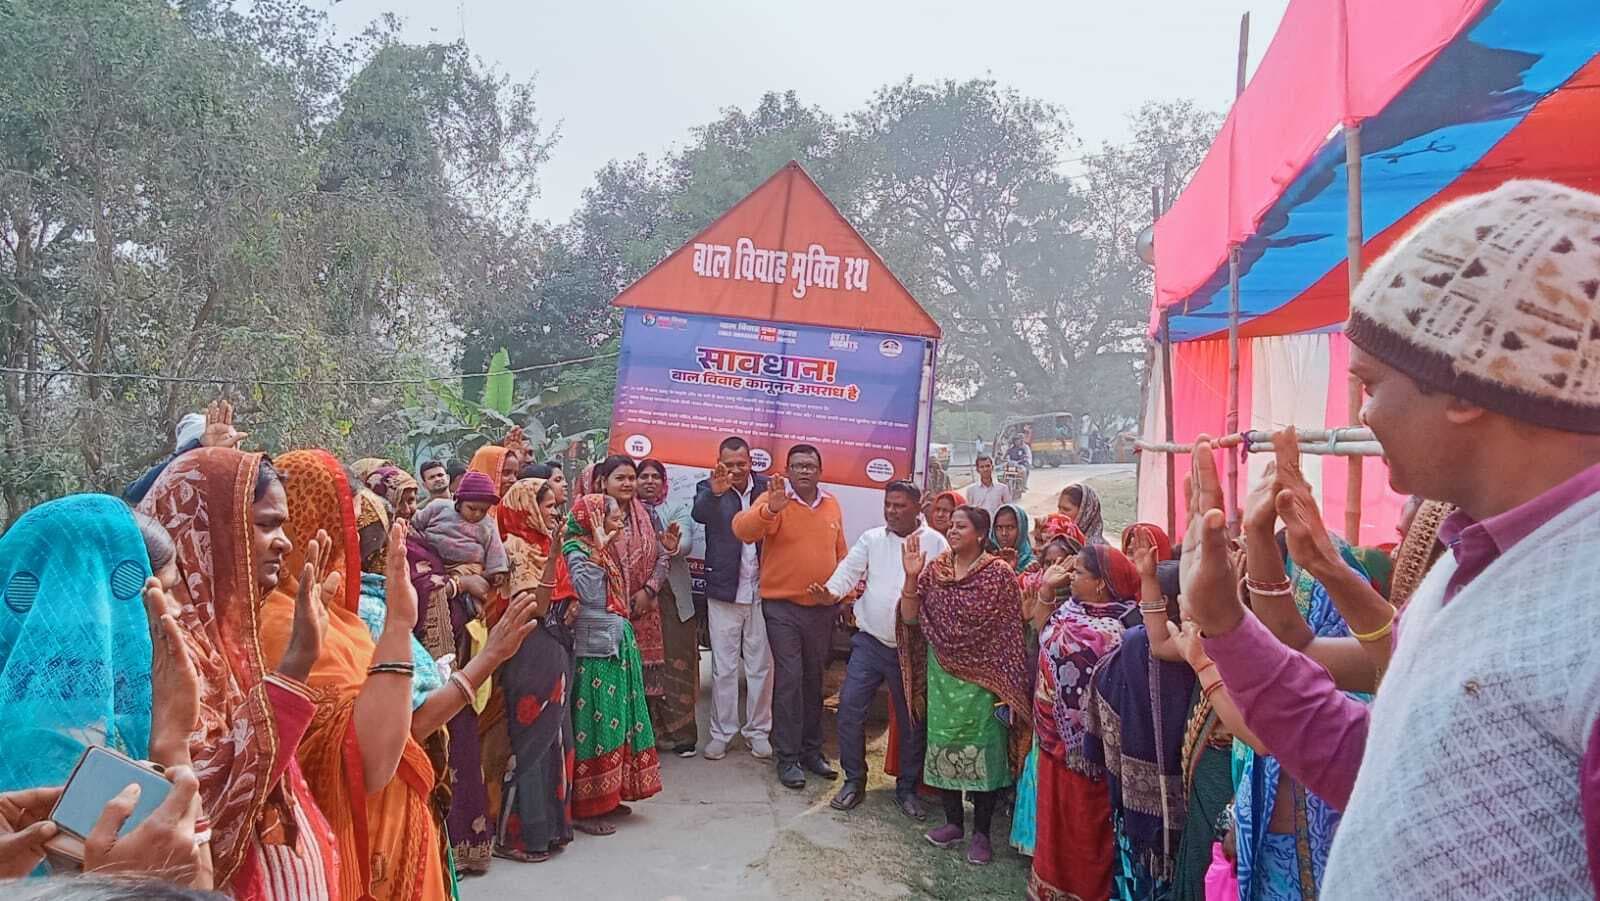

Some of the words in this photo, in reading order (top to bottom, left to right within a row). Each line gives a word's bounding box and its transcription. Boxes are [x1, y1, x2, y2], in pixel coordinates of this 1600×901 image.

[693, 243, 732, 279] बाल
[734, 237, 789, 284] विवाह
[791, 244, 840, 299] मुक्ति
[844, 257, 870, 292] रथ
[696, 346, 838, 384] सावधान!
[670, 369, 700, 384] बाल
[703, 371, 743, 388] विवाह
[746, 377, 794, 396] कानूनन
[796, 384, 846, 398] अपराध
[847, 383, 860, 400] है
